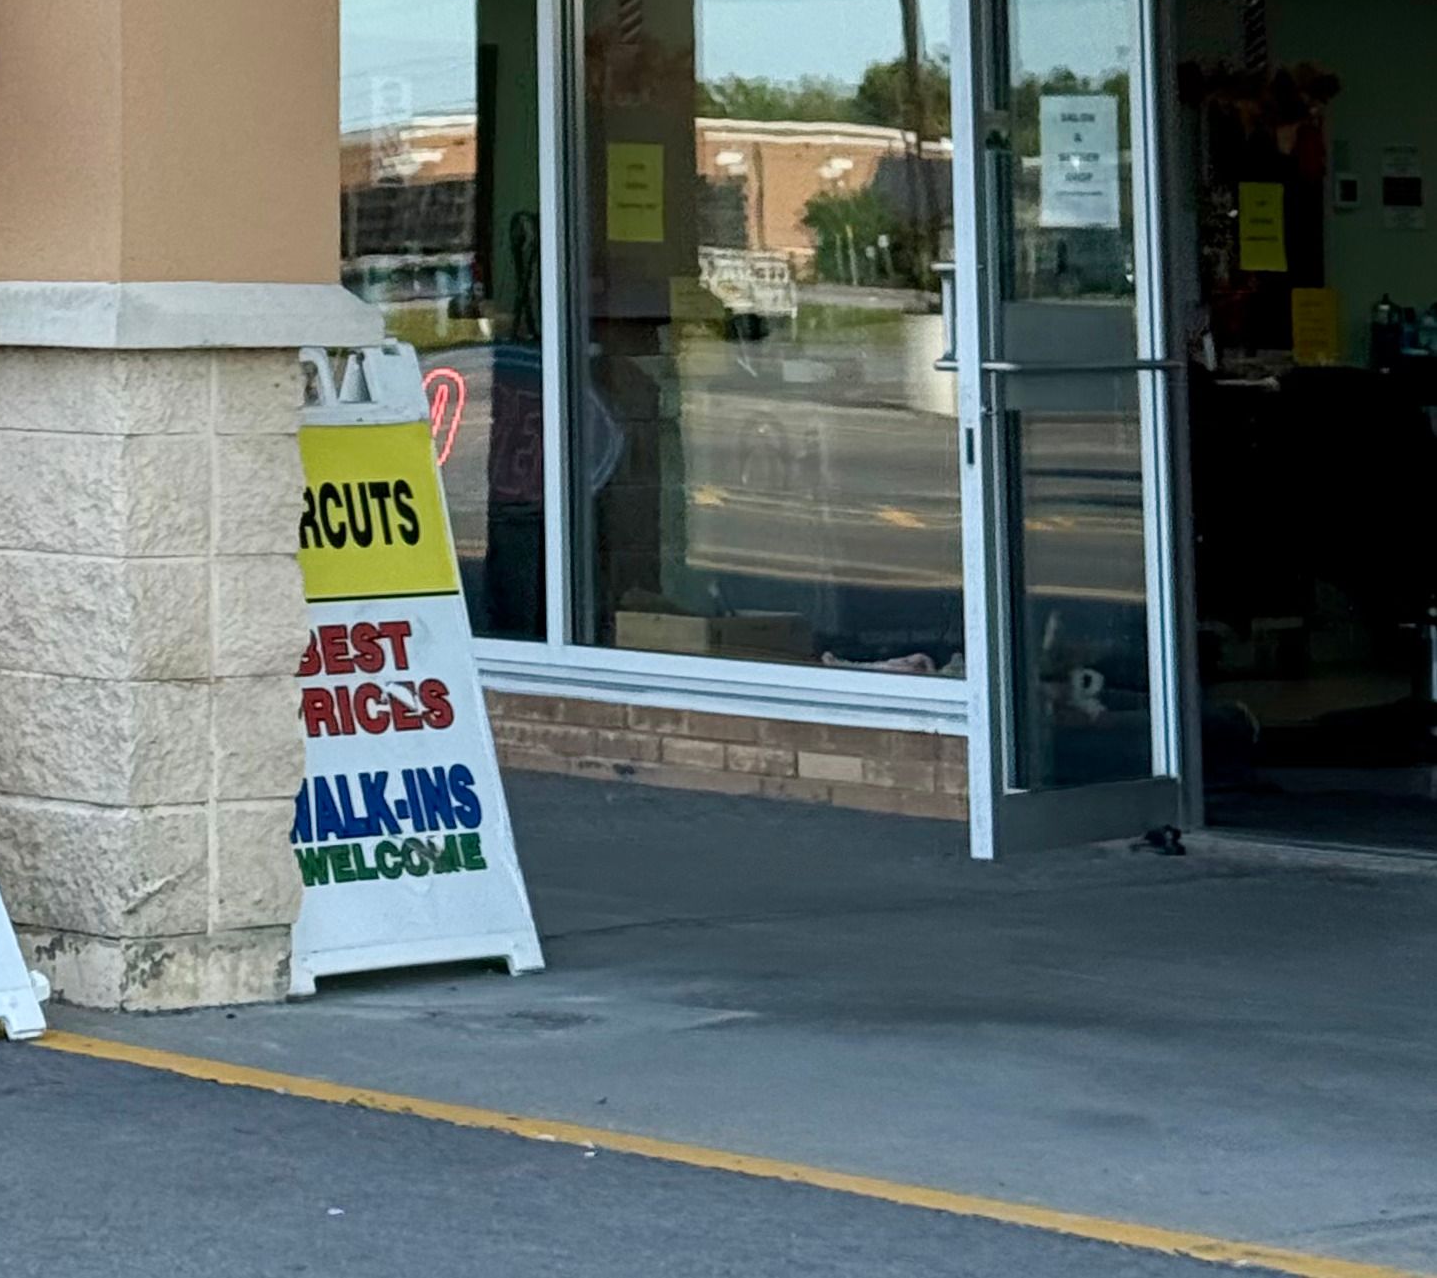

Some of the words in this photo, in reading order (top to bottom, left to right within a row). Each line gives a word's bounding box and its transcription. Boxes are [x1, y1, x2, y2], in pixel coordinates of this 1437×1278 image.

[299, 479, 420, 549] RCUTS
[299, 678, 454, 737] RICES
[293, 832, 488, 887] WELCOME
